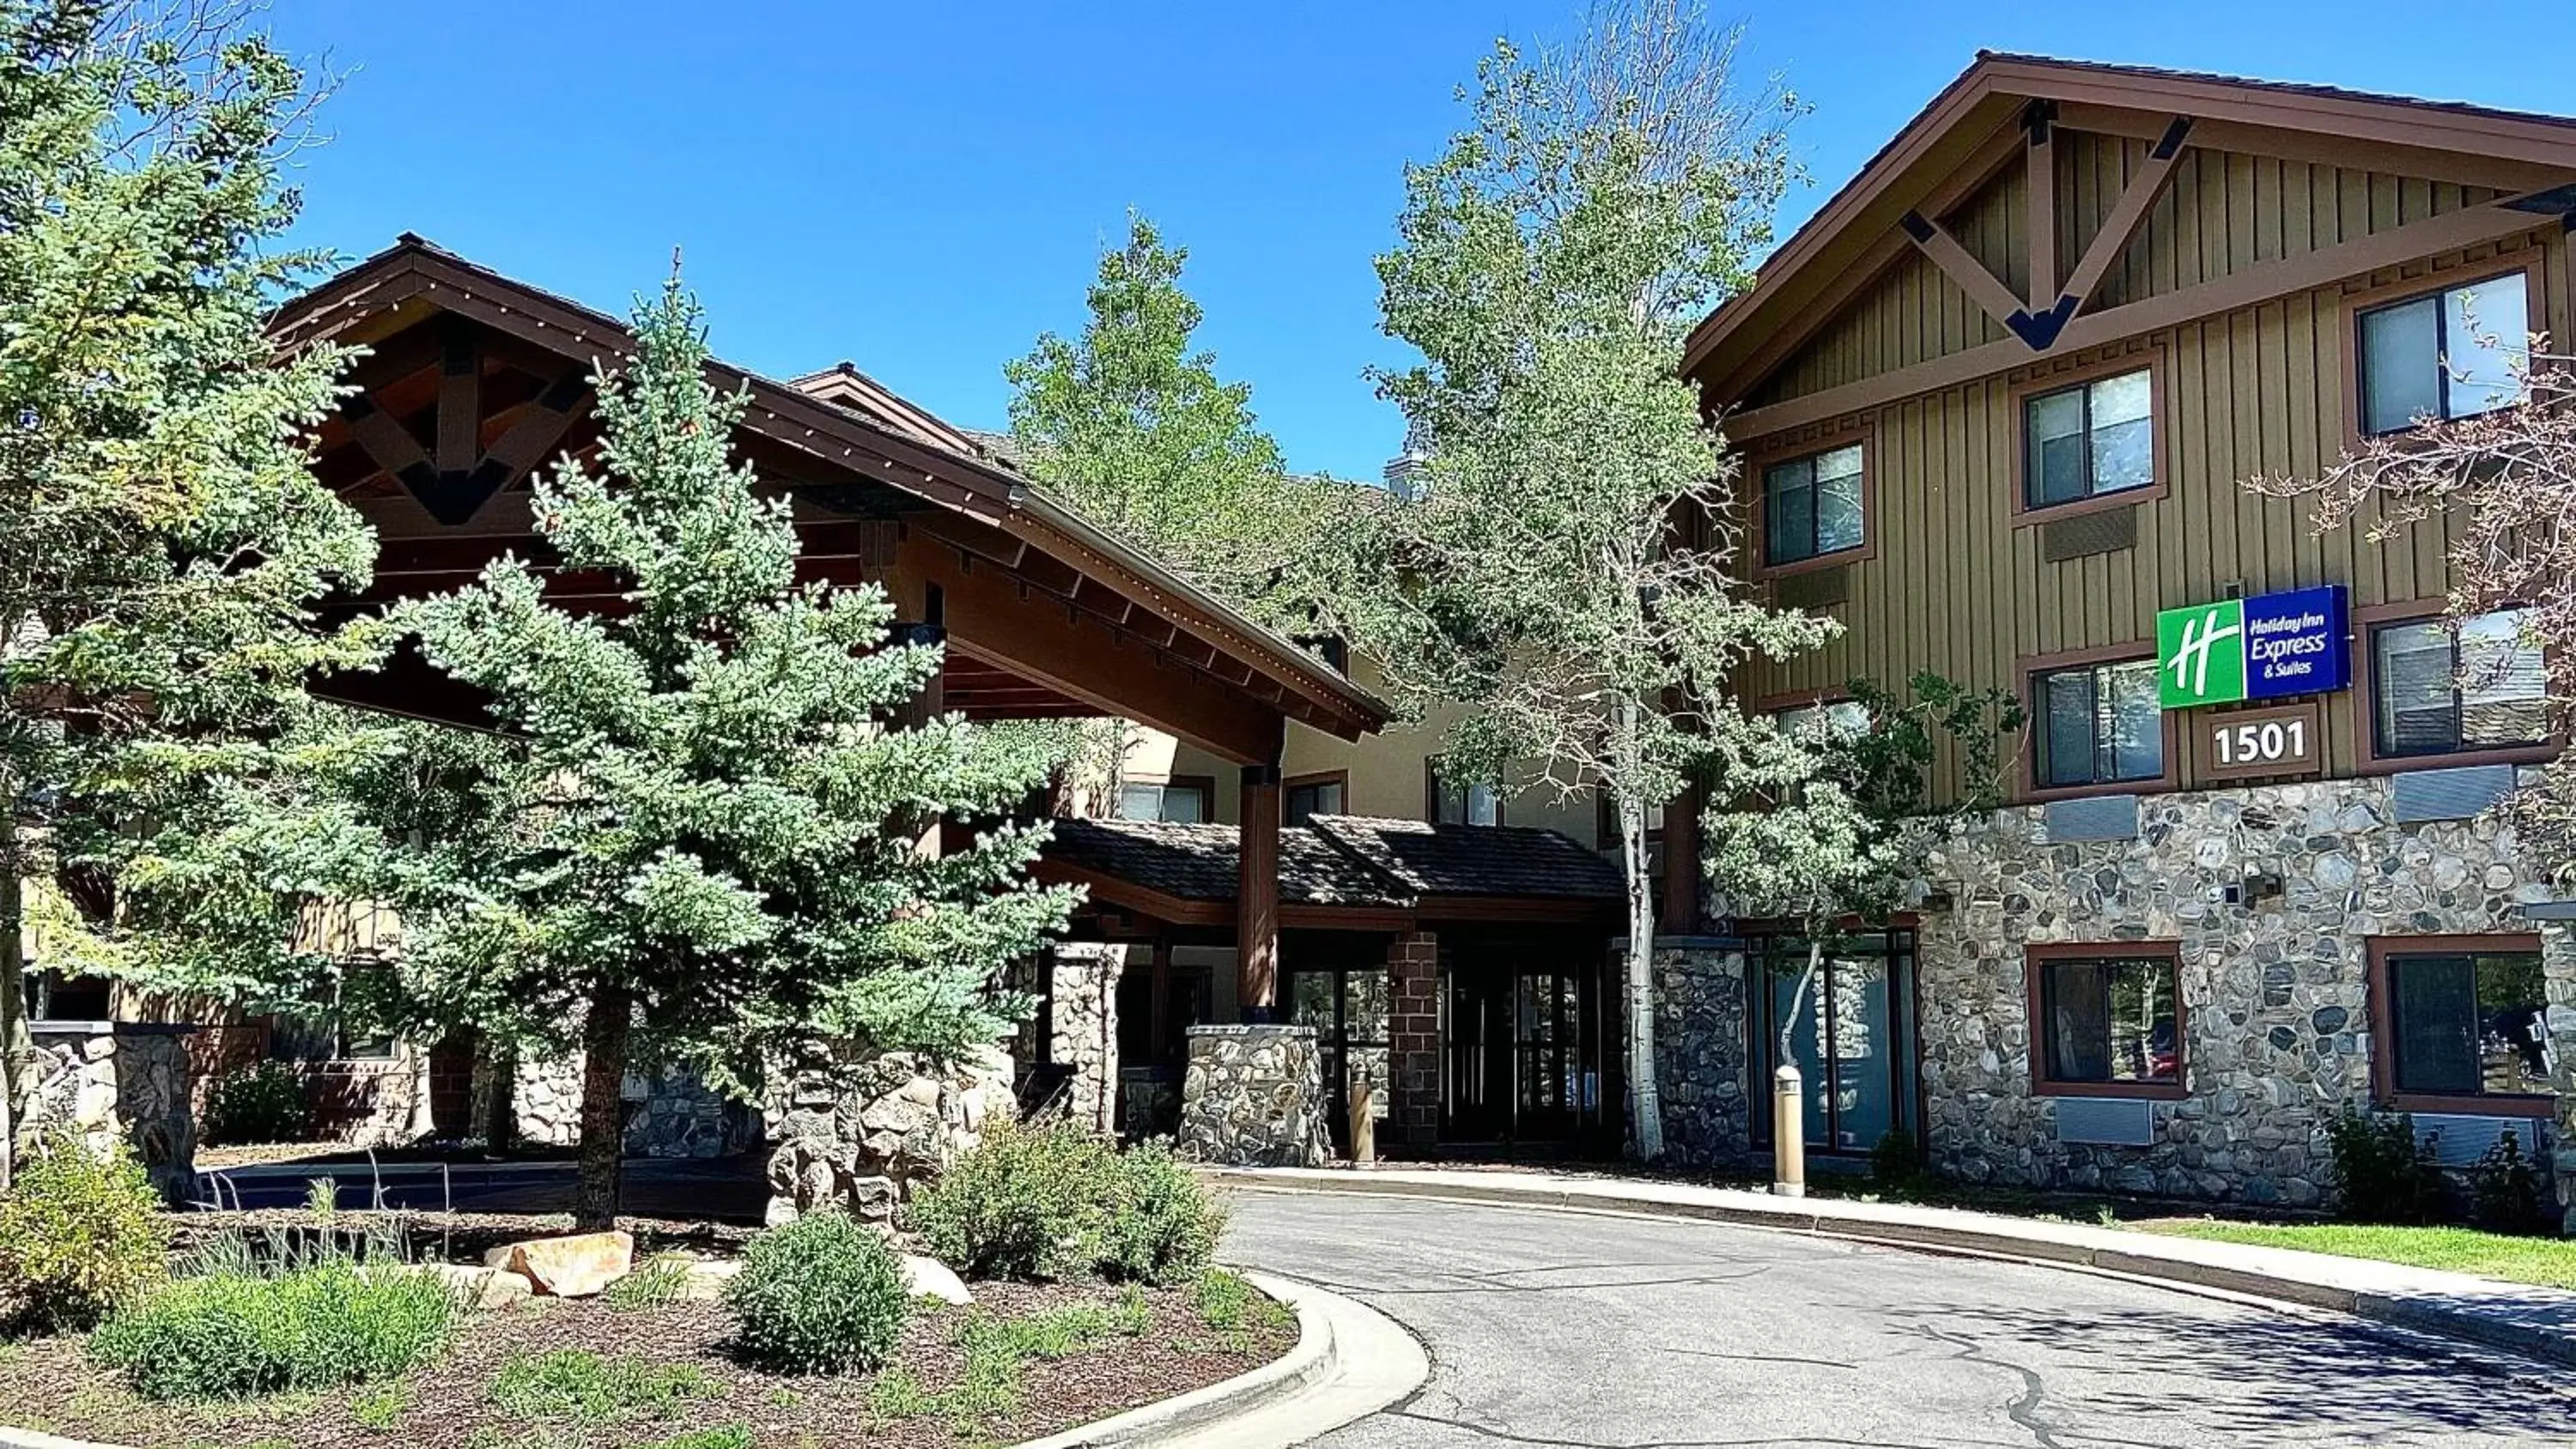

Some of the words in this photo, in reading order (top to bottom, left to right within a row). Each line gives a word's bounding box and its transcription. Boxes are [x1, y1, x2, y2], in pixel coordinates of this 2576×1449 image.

[2251, 615, 2302, 635] Holiday
[2303, 611, 2324, 628] Inn
[2251, 633, 2327, 664] Express
[2264, 664, 2274, 679] &
[2275, 660, 2312, 677] Suites
[2215, 720, 2305, 763] 1501
